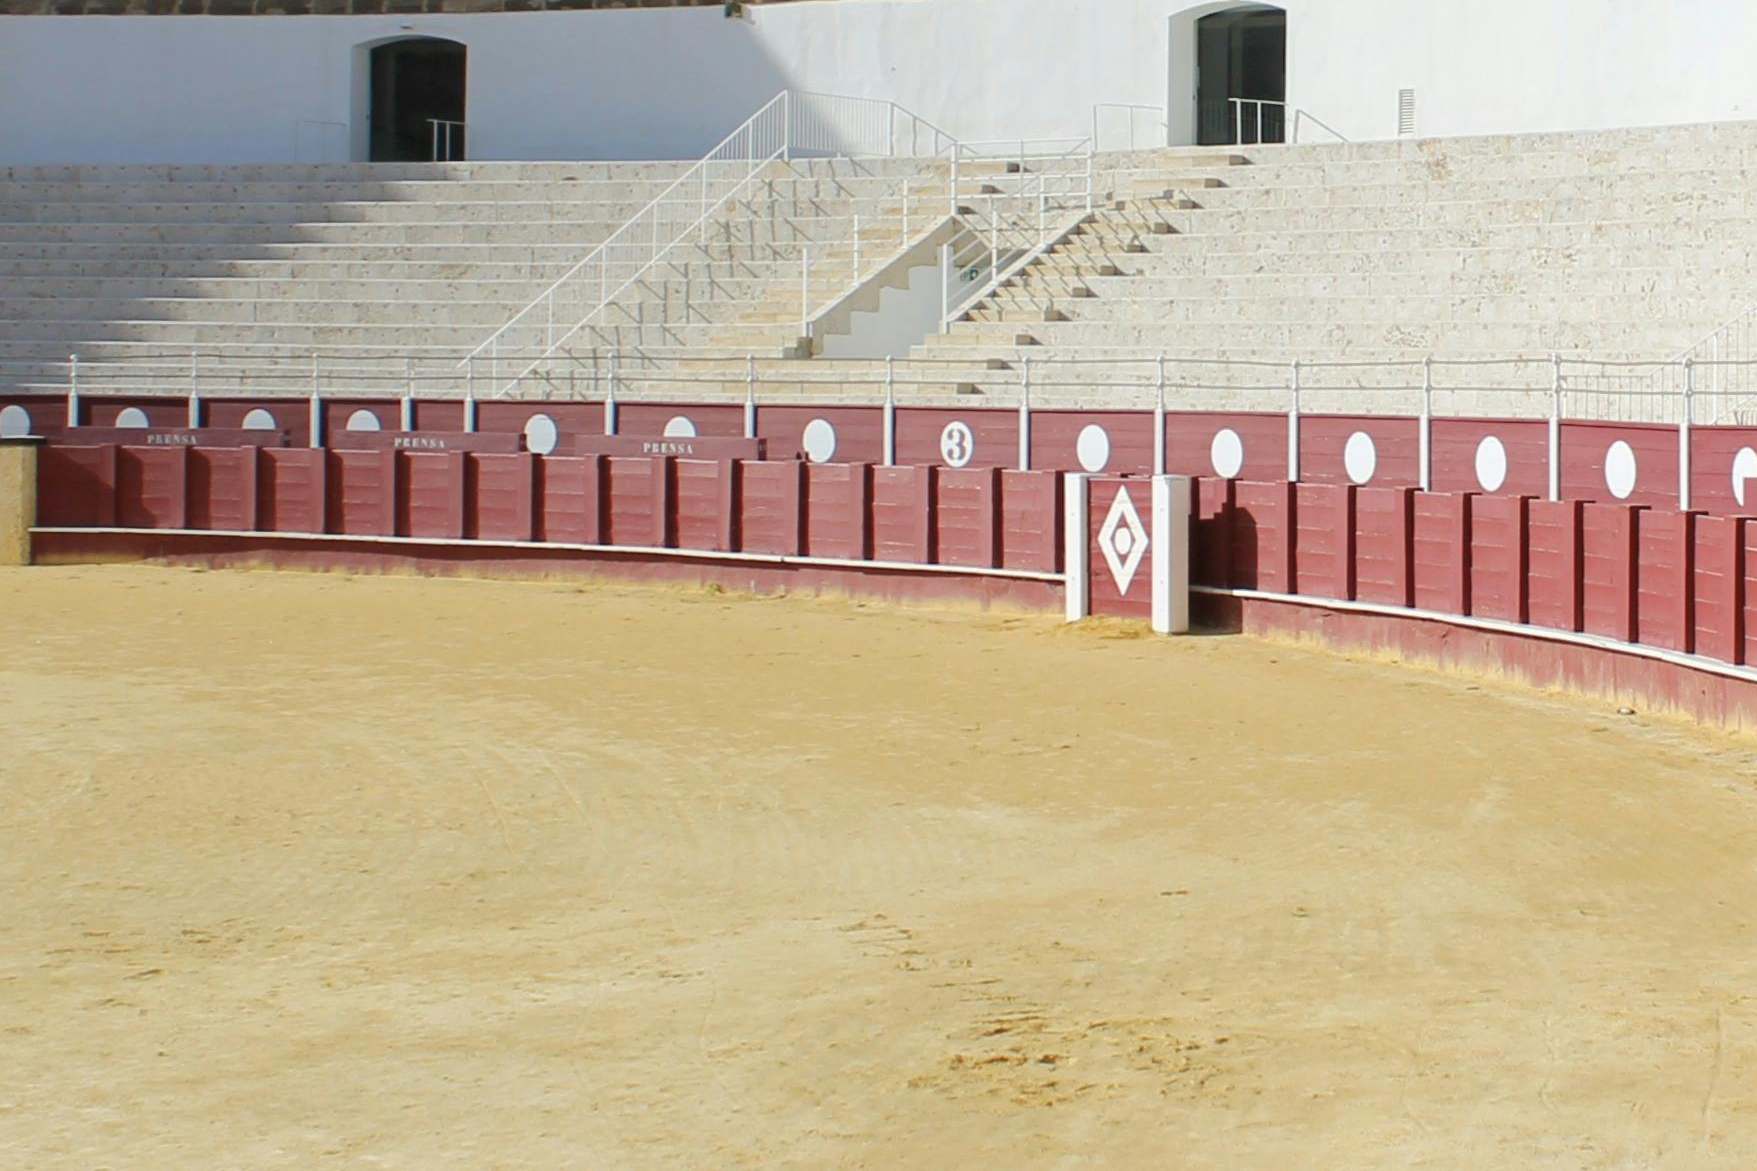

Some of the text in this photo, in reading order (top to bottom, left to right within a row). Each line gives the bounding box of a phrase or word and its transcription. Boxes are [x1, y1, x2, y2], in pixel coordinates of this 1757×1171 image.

[147, 434, 197, 445] PRENSA
[394, 437, 445, 449] PRENSA
[947, 428, 966, 460] 3
[643, 442, 694, 455] PRENSA
